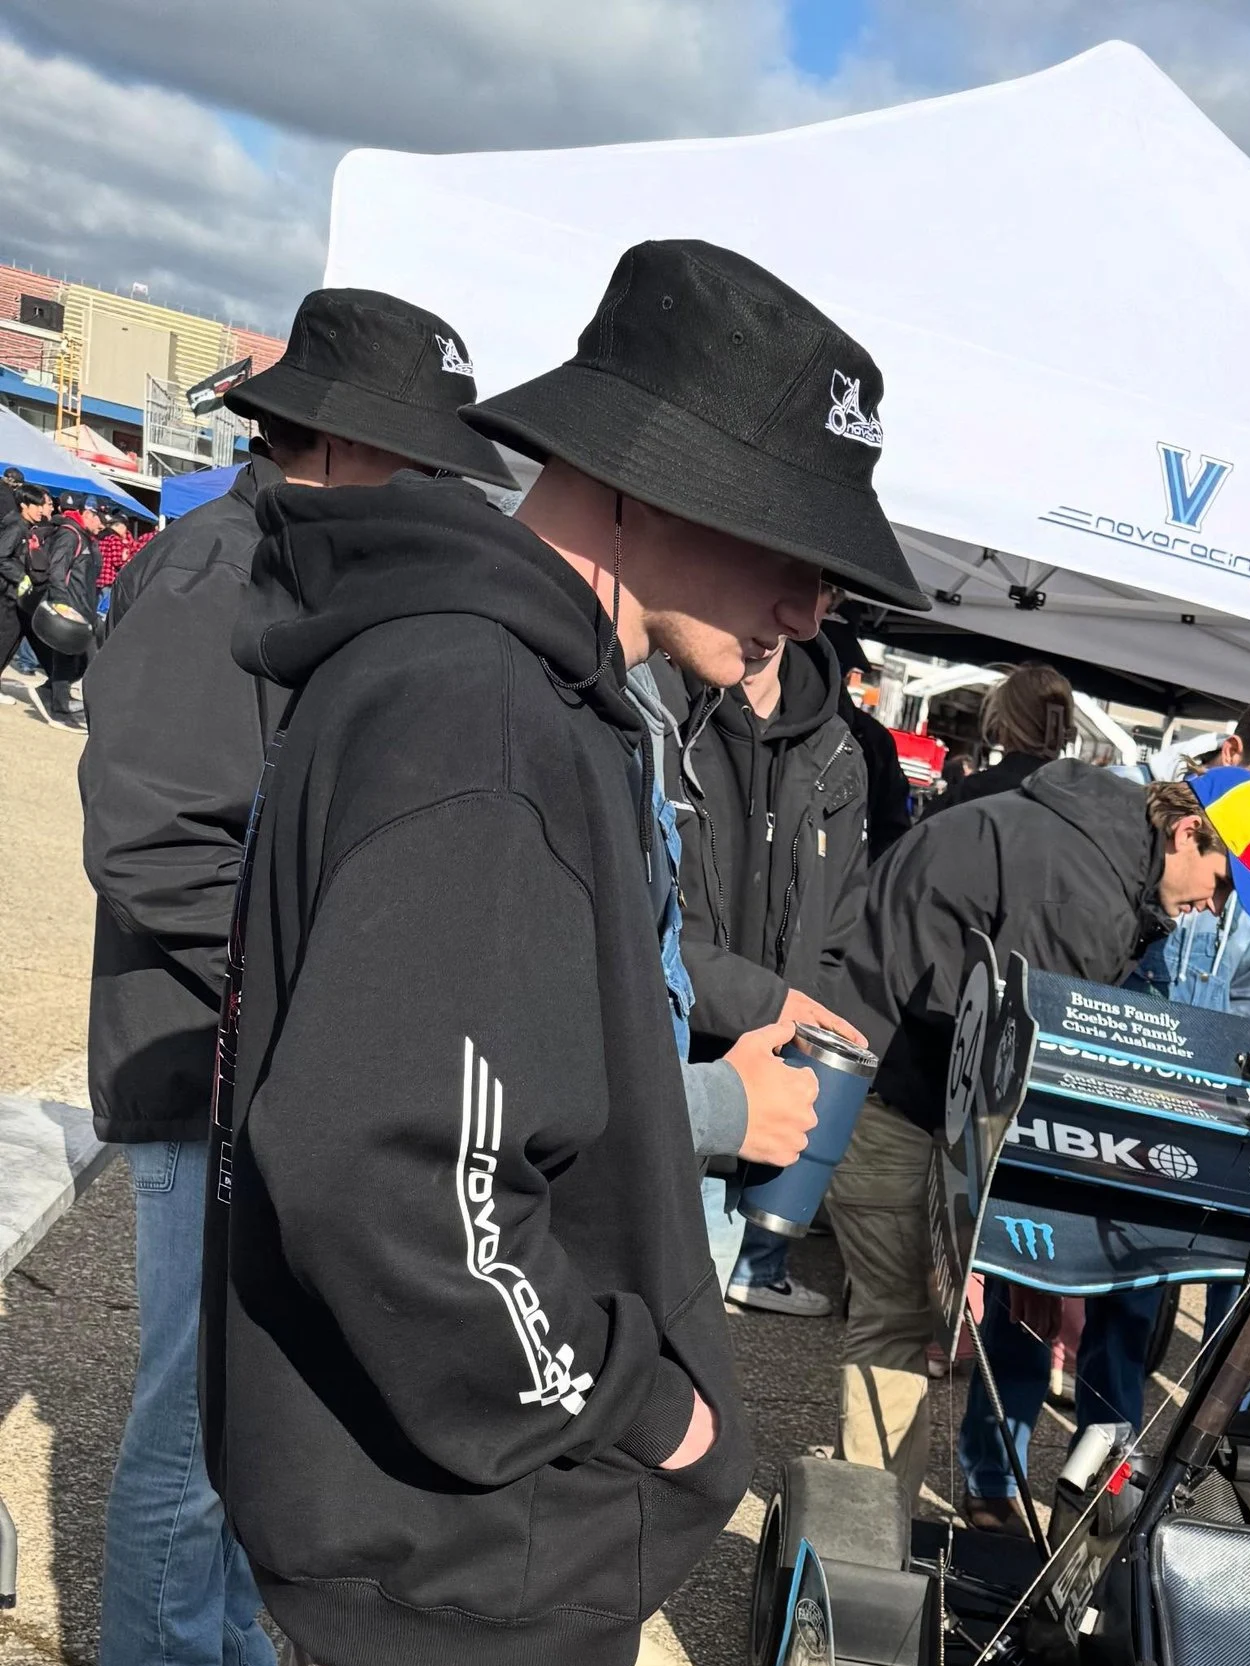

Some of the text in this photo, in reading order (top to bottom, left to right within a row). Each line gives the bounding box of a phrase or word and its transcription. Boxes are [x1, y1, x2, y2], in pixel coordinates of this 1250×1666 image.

[1157, 441, 1234, 533] V
[1066, 1006, 1188, 1047] Koebbe Family
[1070, 991, 1181, 1031] Burns Family
[1062, 1019, 1195, 1060] Chris Auslander
[1005, 1116, 1146, 1170] HBK
